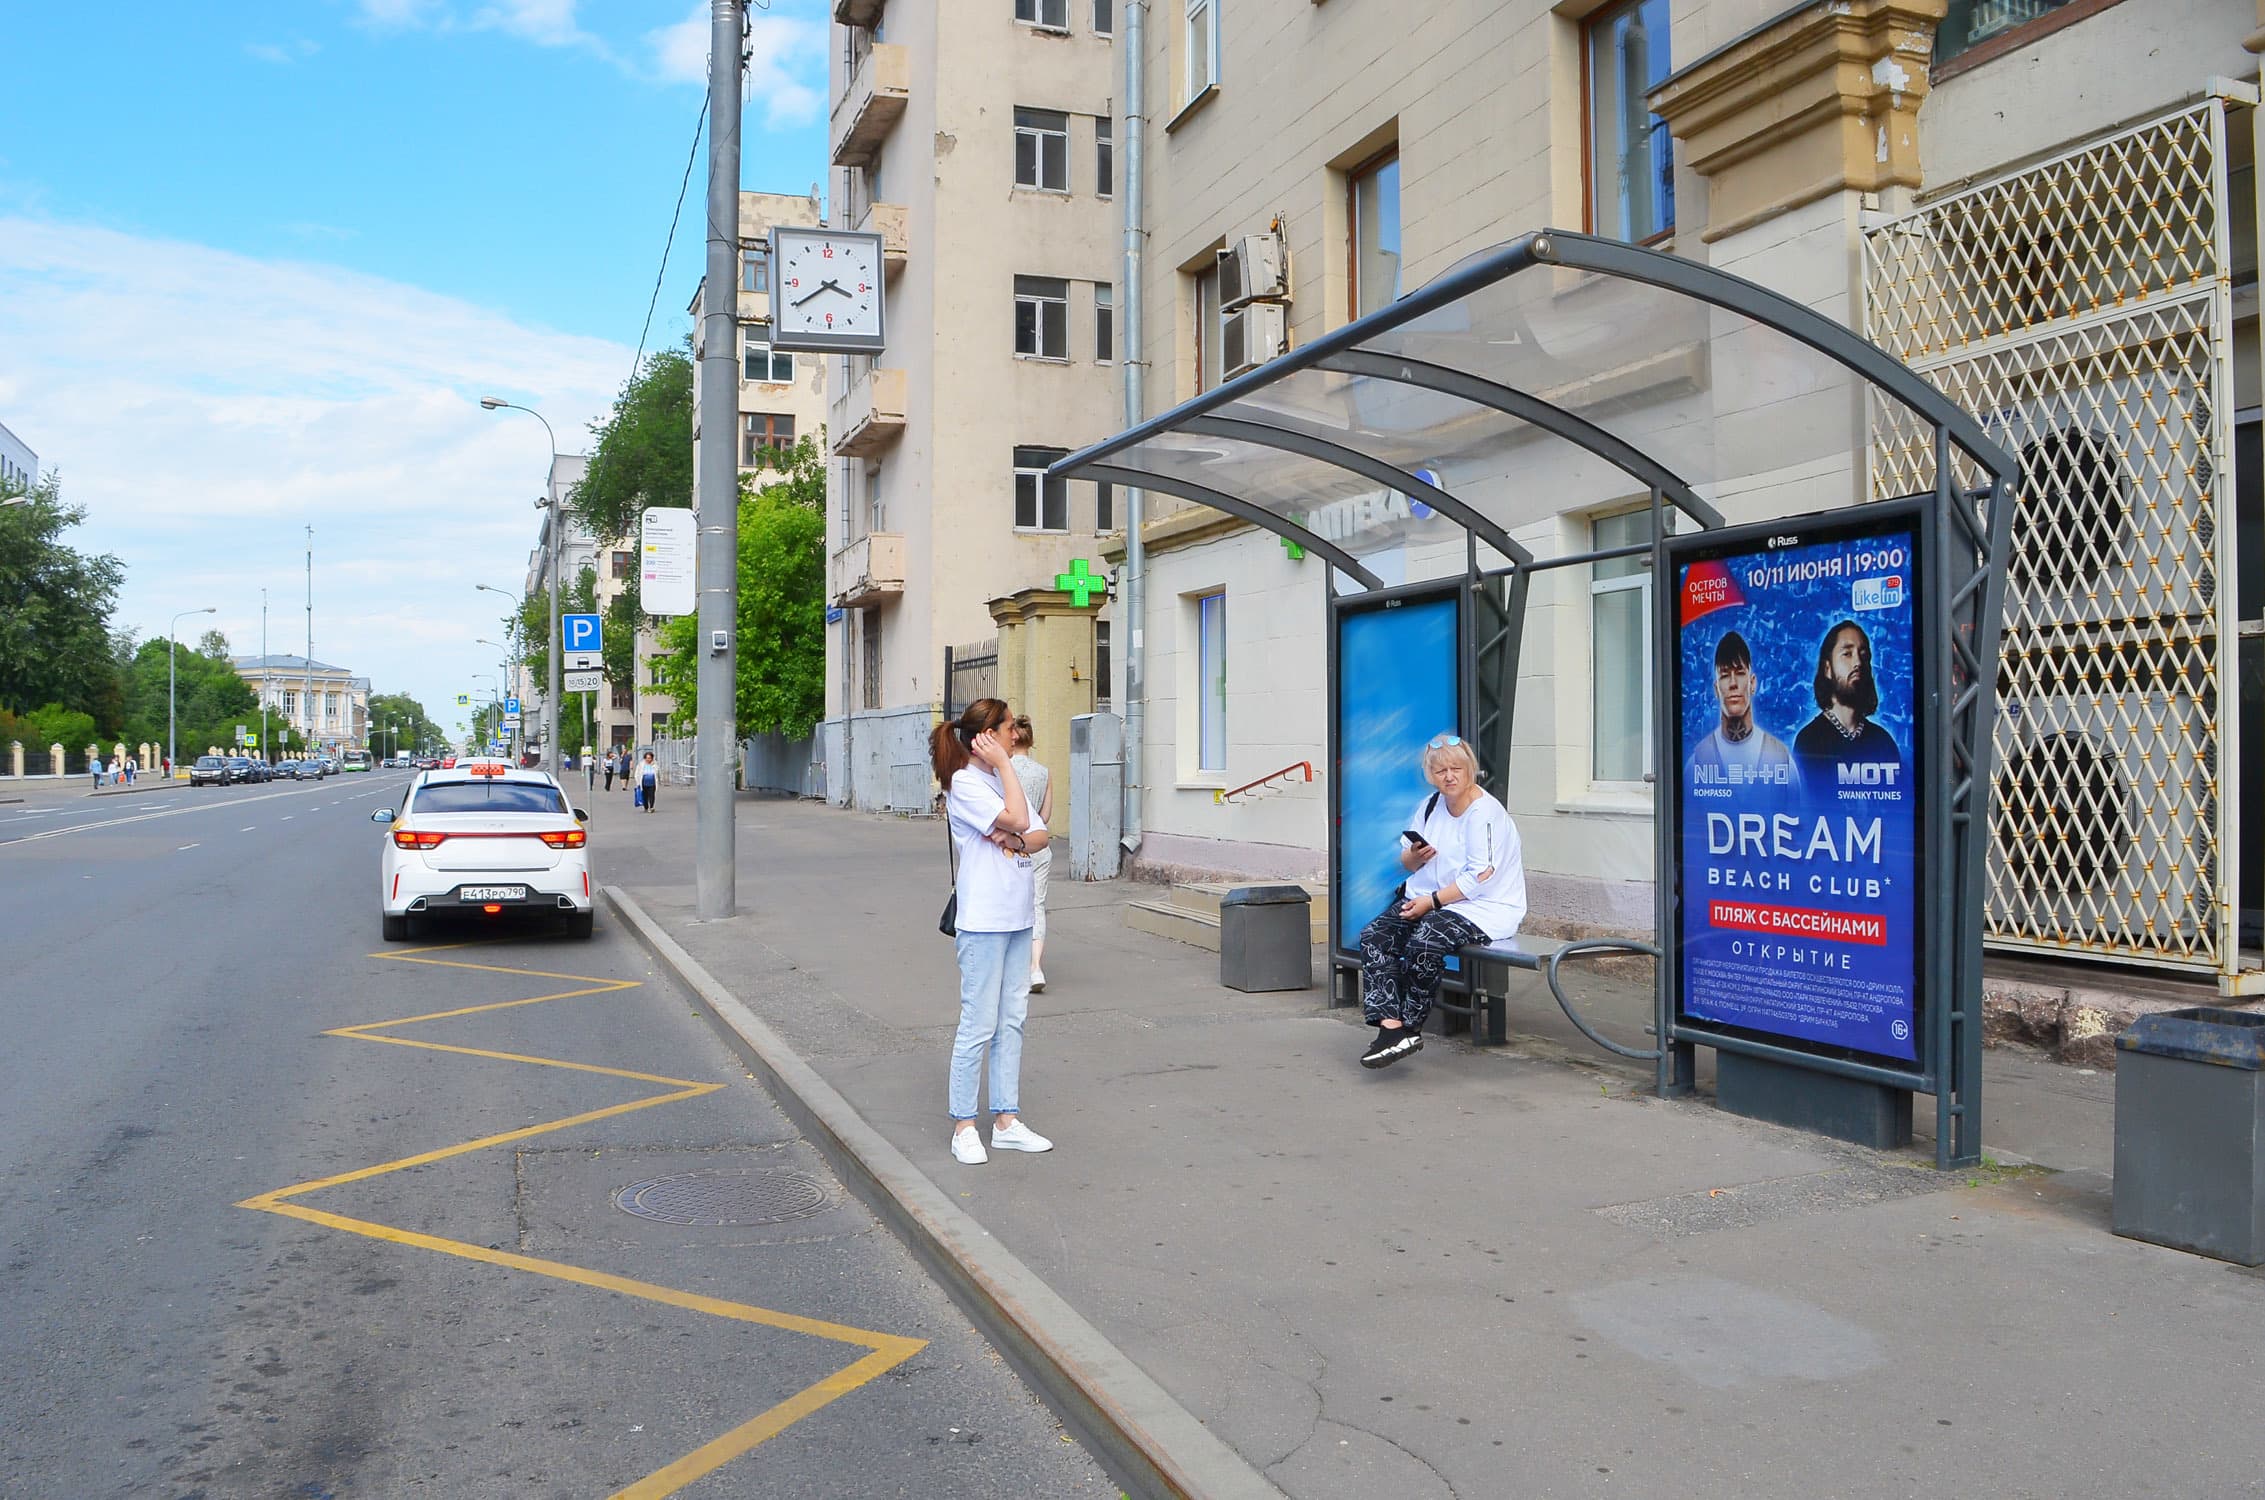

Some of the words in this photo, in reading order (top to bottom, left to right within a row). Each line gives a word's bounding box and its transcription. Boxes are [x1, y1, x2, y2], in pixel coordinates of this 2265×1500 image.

[822, 249, 833, 259] 12
[791, 278, 799, 288] 9
[858, 283, 865, 293] 3
[825, 313, 833, 323] 6
[1777, 536, 1798, 547] Russ
[1747, 566, 1784, 590] 10/11
[1787, 558, 1842, 583] ИЮНЯ
[1854, 548, 1903, 572] 19:00
[1689, 577, 1728, 593] ОСТРОВ
[1692, 590, 1725, 605] МЕЧТЫ
[1855, 588, 1880, 606] Like
[573, 619, 593, 647] P
[587, 677, 598, 686] 20
[508, 702, 517, 712] P
[1693, 788, 1733, 798] ROMPASSO
[1837, 790, 1872, 800] SWANKY
[1873, 791, 1902, 801] TUNES
[1707, 812, 1882, 864] DREAM
[1707, 868, 1790, 891] BEACH
[1713, 906, 1757, 925] ПЛЯЖ
[1759, 910, 1769, 926] С
[1772, 911, 1880, 938] БАССЕЙНАМИ
[1732, 941, 1851, 970] ОТКРЫТИЕ
[1894, 1022, 1907, 1036] 16+
